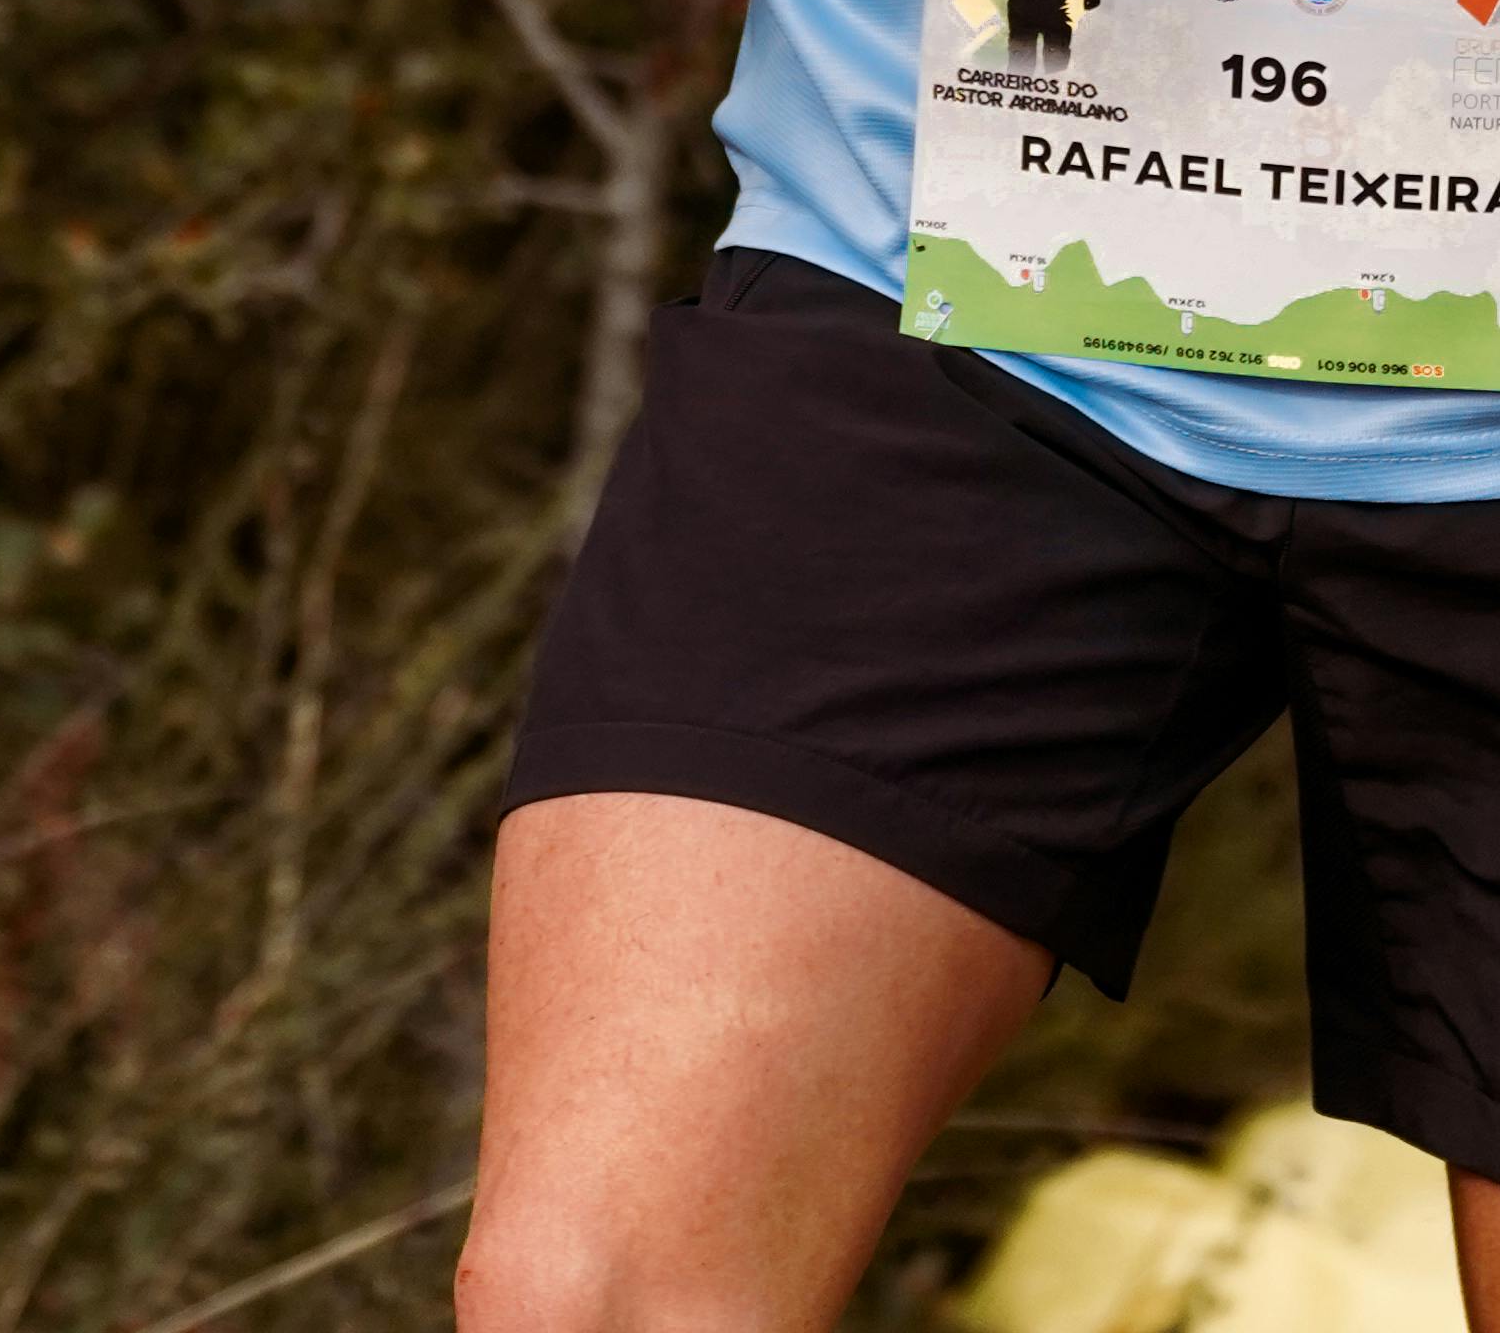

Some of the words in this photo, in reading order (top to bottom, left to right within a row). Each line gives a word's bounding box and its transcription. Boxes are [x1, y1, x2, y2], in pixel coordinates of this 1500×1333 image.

[957, 68, 1060, 95] CARREIROS
[1067, 81, 1098, 99] DO
[1220, 54, 1328, 107] 196
[933, 85, 1004, 107] PASTOR
[1009, 93, 1129, 122] ARRIMALANO
[1020, 135, 1243, 197] RAFAEL
[1176, 346, 1204, 360] 808
[1209, 349, 1234, 363] 762
[1239, 352, 1263, 365] 912
[1318, 359, 1346, 371] 601
[1348, 361, 1377, 373] 806
[1381, 363, 1409, 375] 966
[1412, 364, 1444, 378] SOS
